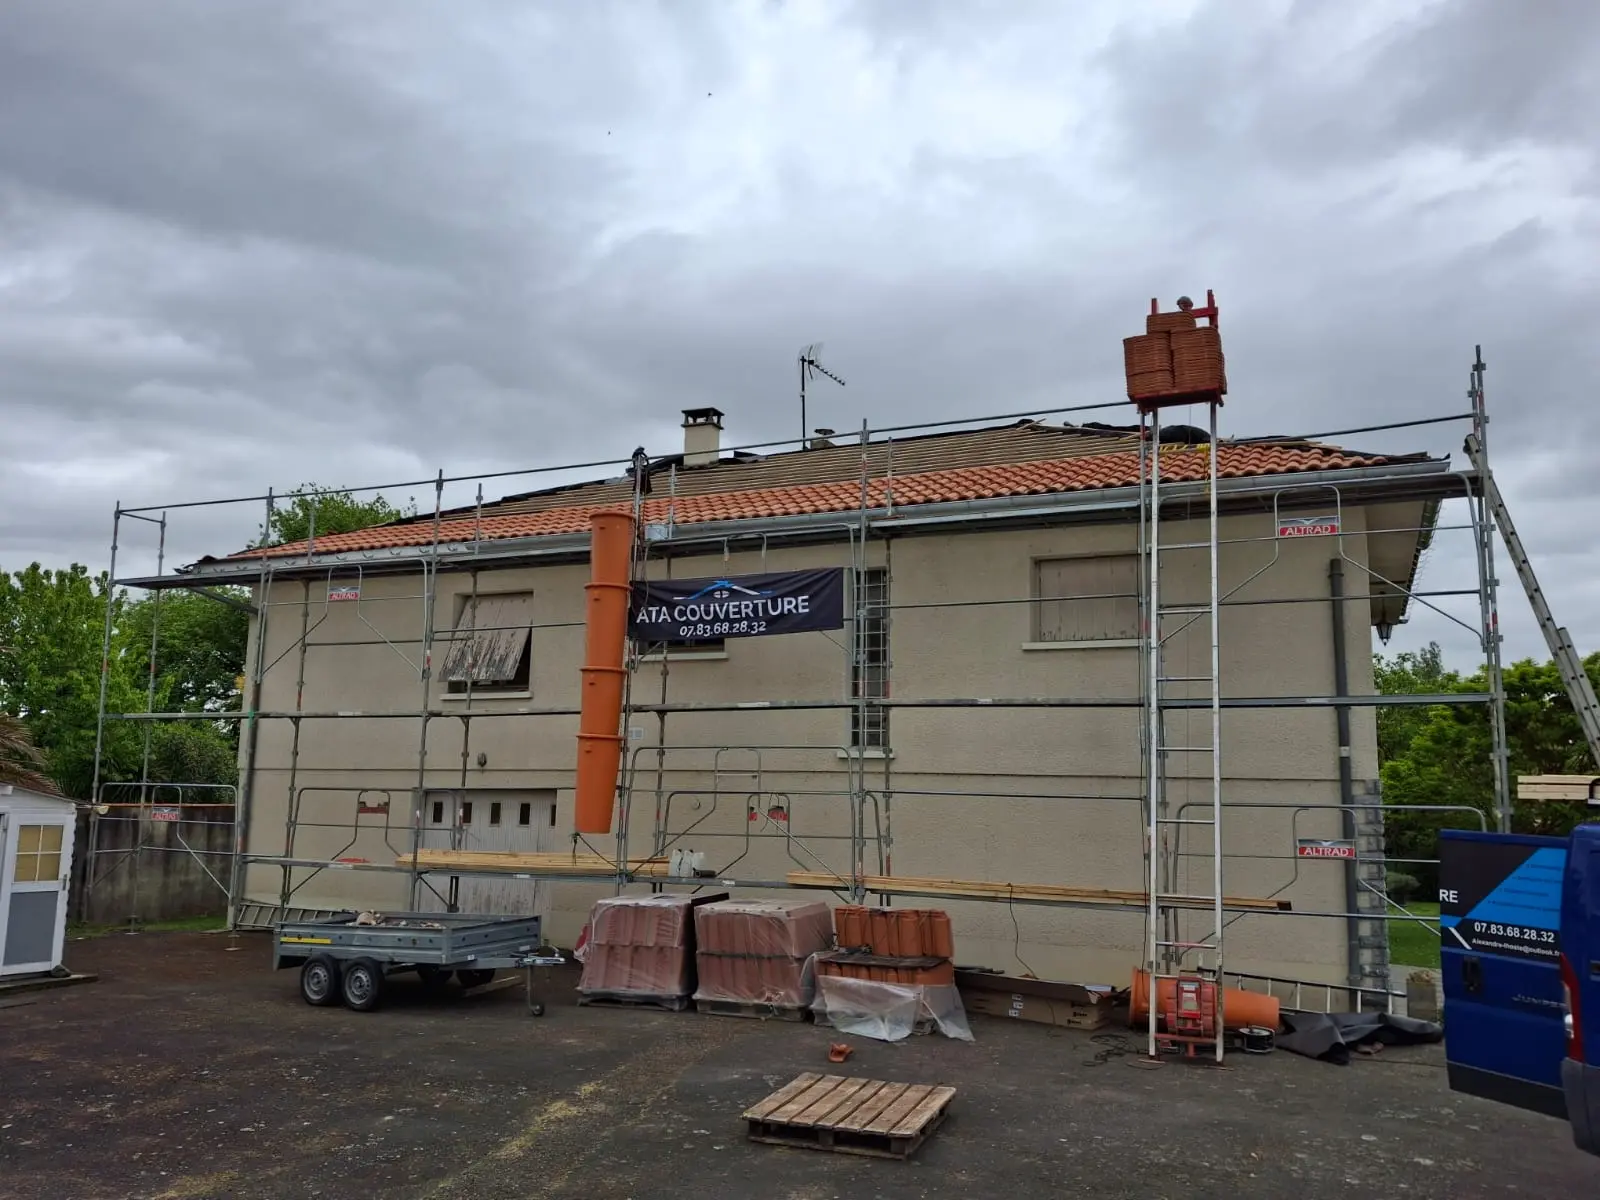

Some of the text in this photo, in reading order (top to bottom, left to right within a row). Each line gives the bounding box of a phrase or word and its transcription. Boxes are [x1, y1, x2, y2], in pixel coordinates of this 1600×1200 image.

[1284, 525, 1332, 536] ALTRAD
[636, 595, 810, 624] ATA COUVERTURE
[679, 620, 767, 637] 07.83.68.28.32
[1303, 847, 1349, 857] ALTRAD
[1439, 889, 1459, 903] RE
[1474, 921, 1556, 943] 07.83.68.28.32
